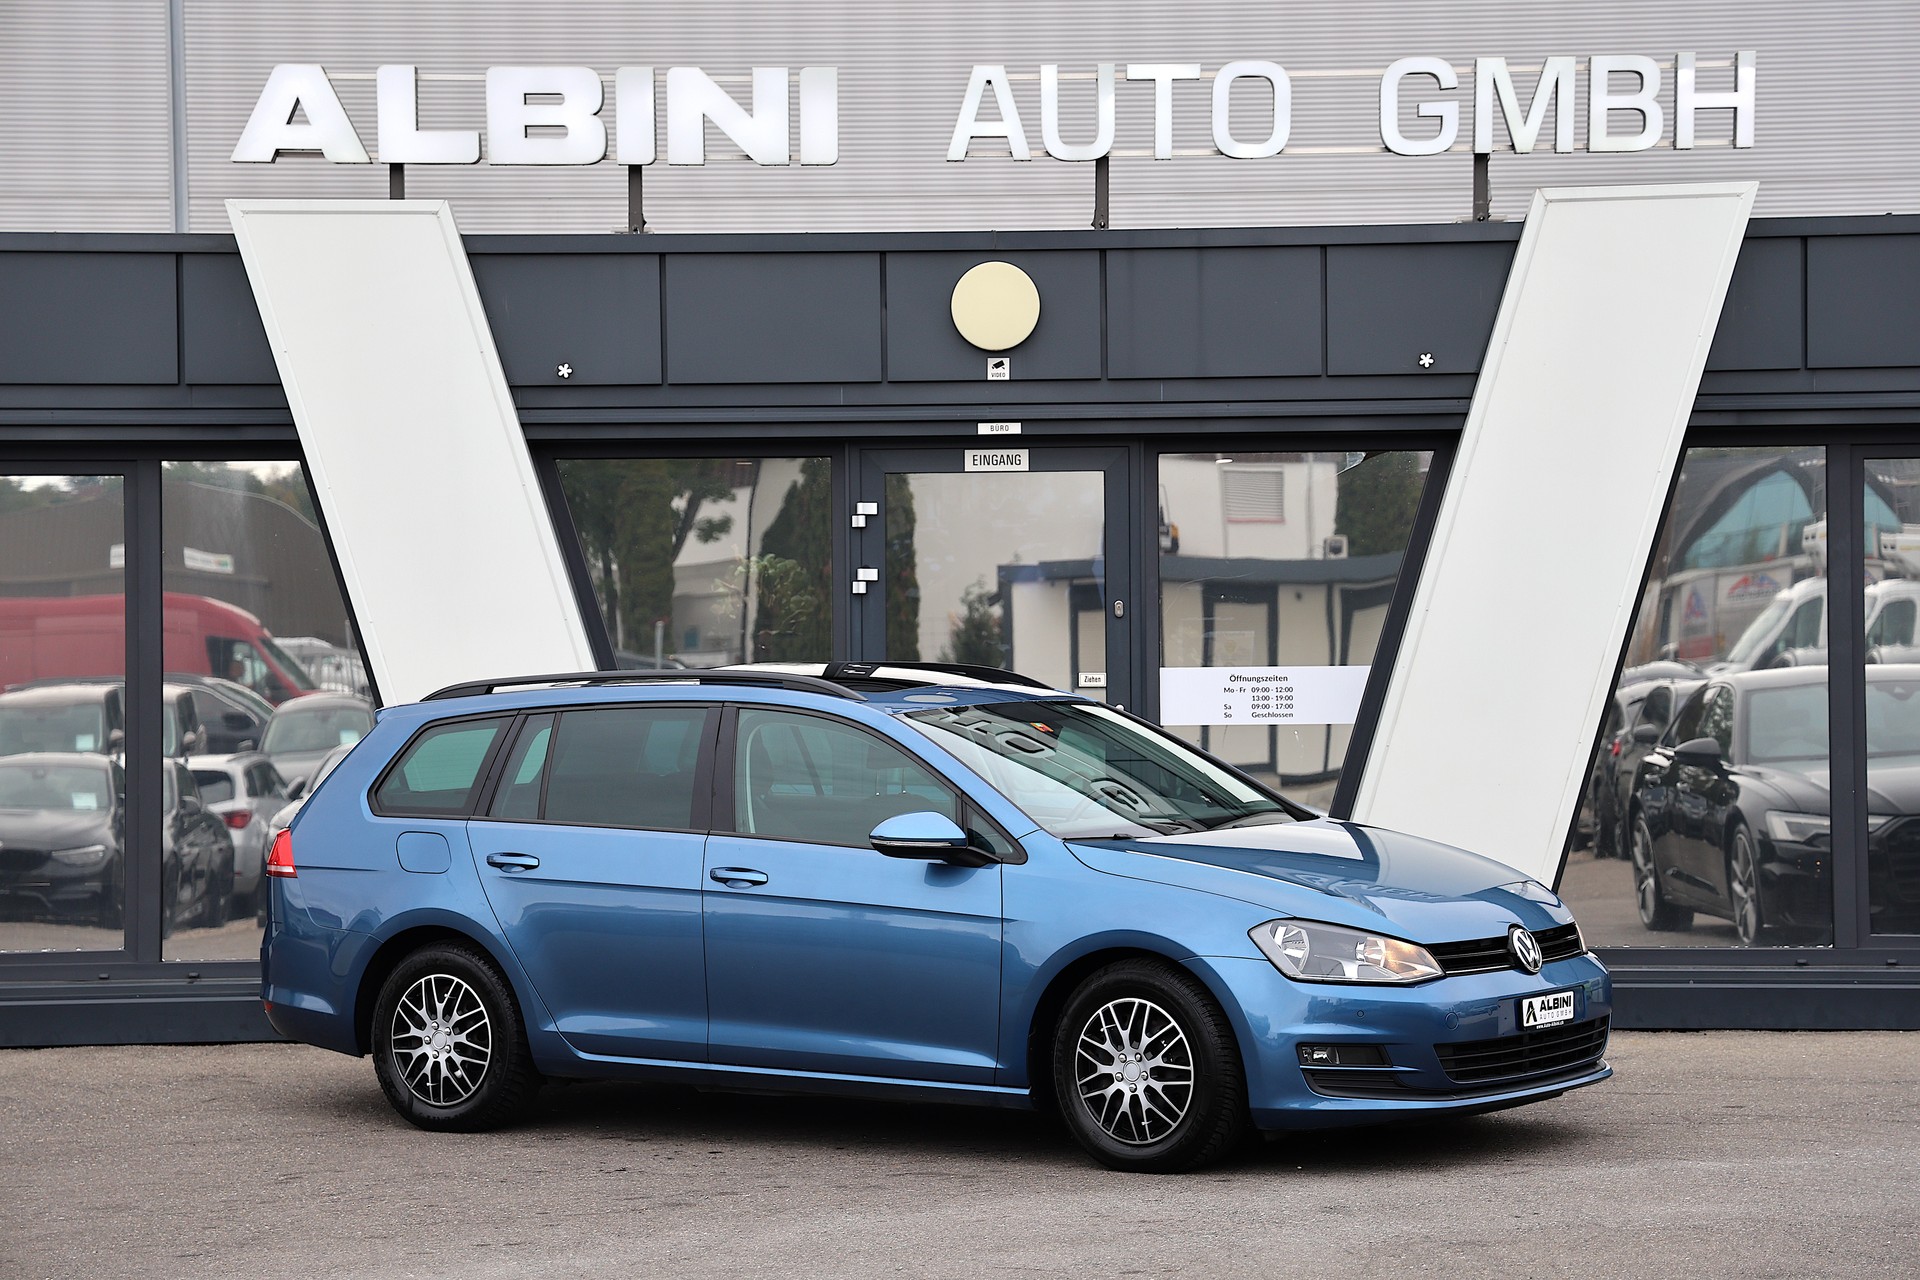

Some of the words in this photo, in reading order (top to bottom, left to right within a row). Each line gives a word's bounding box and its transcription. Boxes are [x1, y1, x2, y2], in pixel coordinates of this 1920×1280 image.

[231, 63, 839, 166] ALBINI
[946, 60, 1292, 162] AUTO
[1379, 50, 1757, 156] GMBH
[990, 424, 1010, 432] BÜRO
[972, 454, 1022, 466] EINGANG
[1084, 675, 1102, 683] Ziehen
[1229, 674, 1288, 683] Öffnungszeiten
[1540, 995, 1572, 1012] ALBINI
[1539, 1011, 1555, 1020] AUTO
[1556, 1009, 1572, 1018] GMBH
